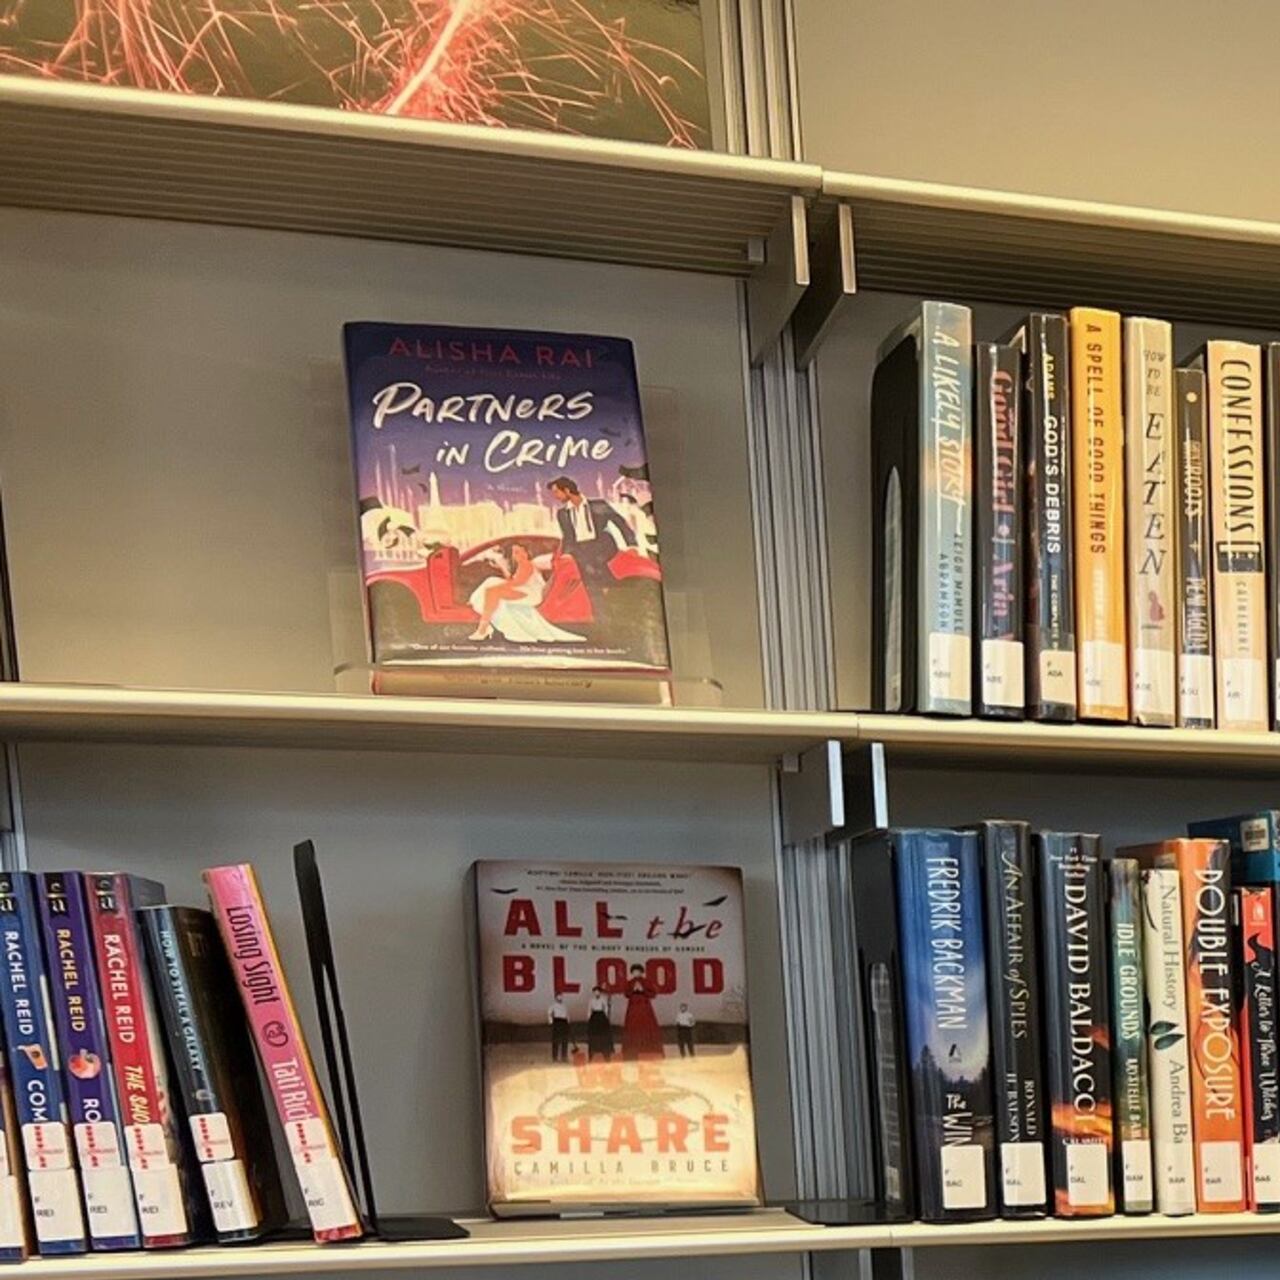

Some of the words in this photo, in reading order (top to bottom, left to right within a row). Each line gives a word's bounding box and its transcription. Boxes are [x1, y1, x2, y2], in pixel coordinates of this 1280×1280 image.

[389, 338, 520, 364] ALISHA
[537, 345, 594, 369] RAI
[1044, 416, 1059, 477] GOD'S
[1220, 358, 1256, 534] CONFESSIONS
[1045, 482, 1061, 554] DEBRIS
[503, 898, 625, 938] ALL
[925, 856, 960, 931] FREDRIK
[1160, 884, 1176, 946] Natural
[1193, 868, 1229, 975] DOUBLE
[225, 904, 264, 960] Losing
[245, 960, 280, 1006] Sight
[1063, 882, 1088, 975] DAVID
[1115, 922, 1135, 957] IDLE
[4, 930, 28, 993] RACHEL
[103, 933, 131, 1001] RACHEL
[502, 955, 724, 994] BLOOD
[932, 938, 967, 1030] BACKMAN
[1162, 949, 1179, 1012] History
[15, 998, 34, 1036] REID
[114, 1004, 136, 1044] REID
[1118, 964, 1141, 1041] GROUNDS
[571, 1050, 666, 1090] WE
[1068, 982, 1098, 1122] BALDACCI
[1202, 977, 1236, 1121] EXPOSURE
[511, 1114, 731, 1154] SHARE
[513, 1159, 624, 1176] CAMILLA
[651, 1159, 729, 1172] BRUCE
